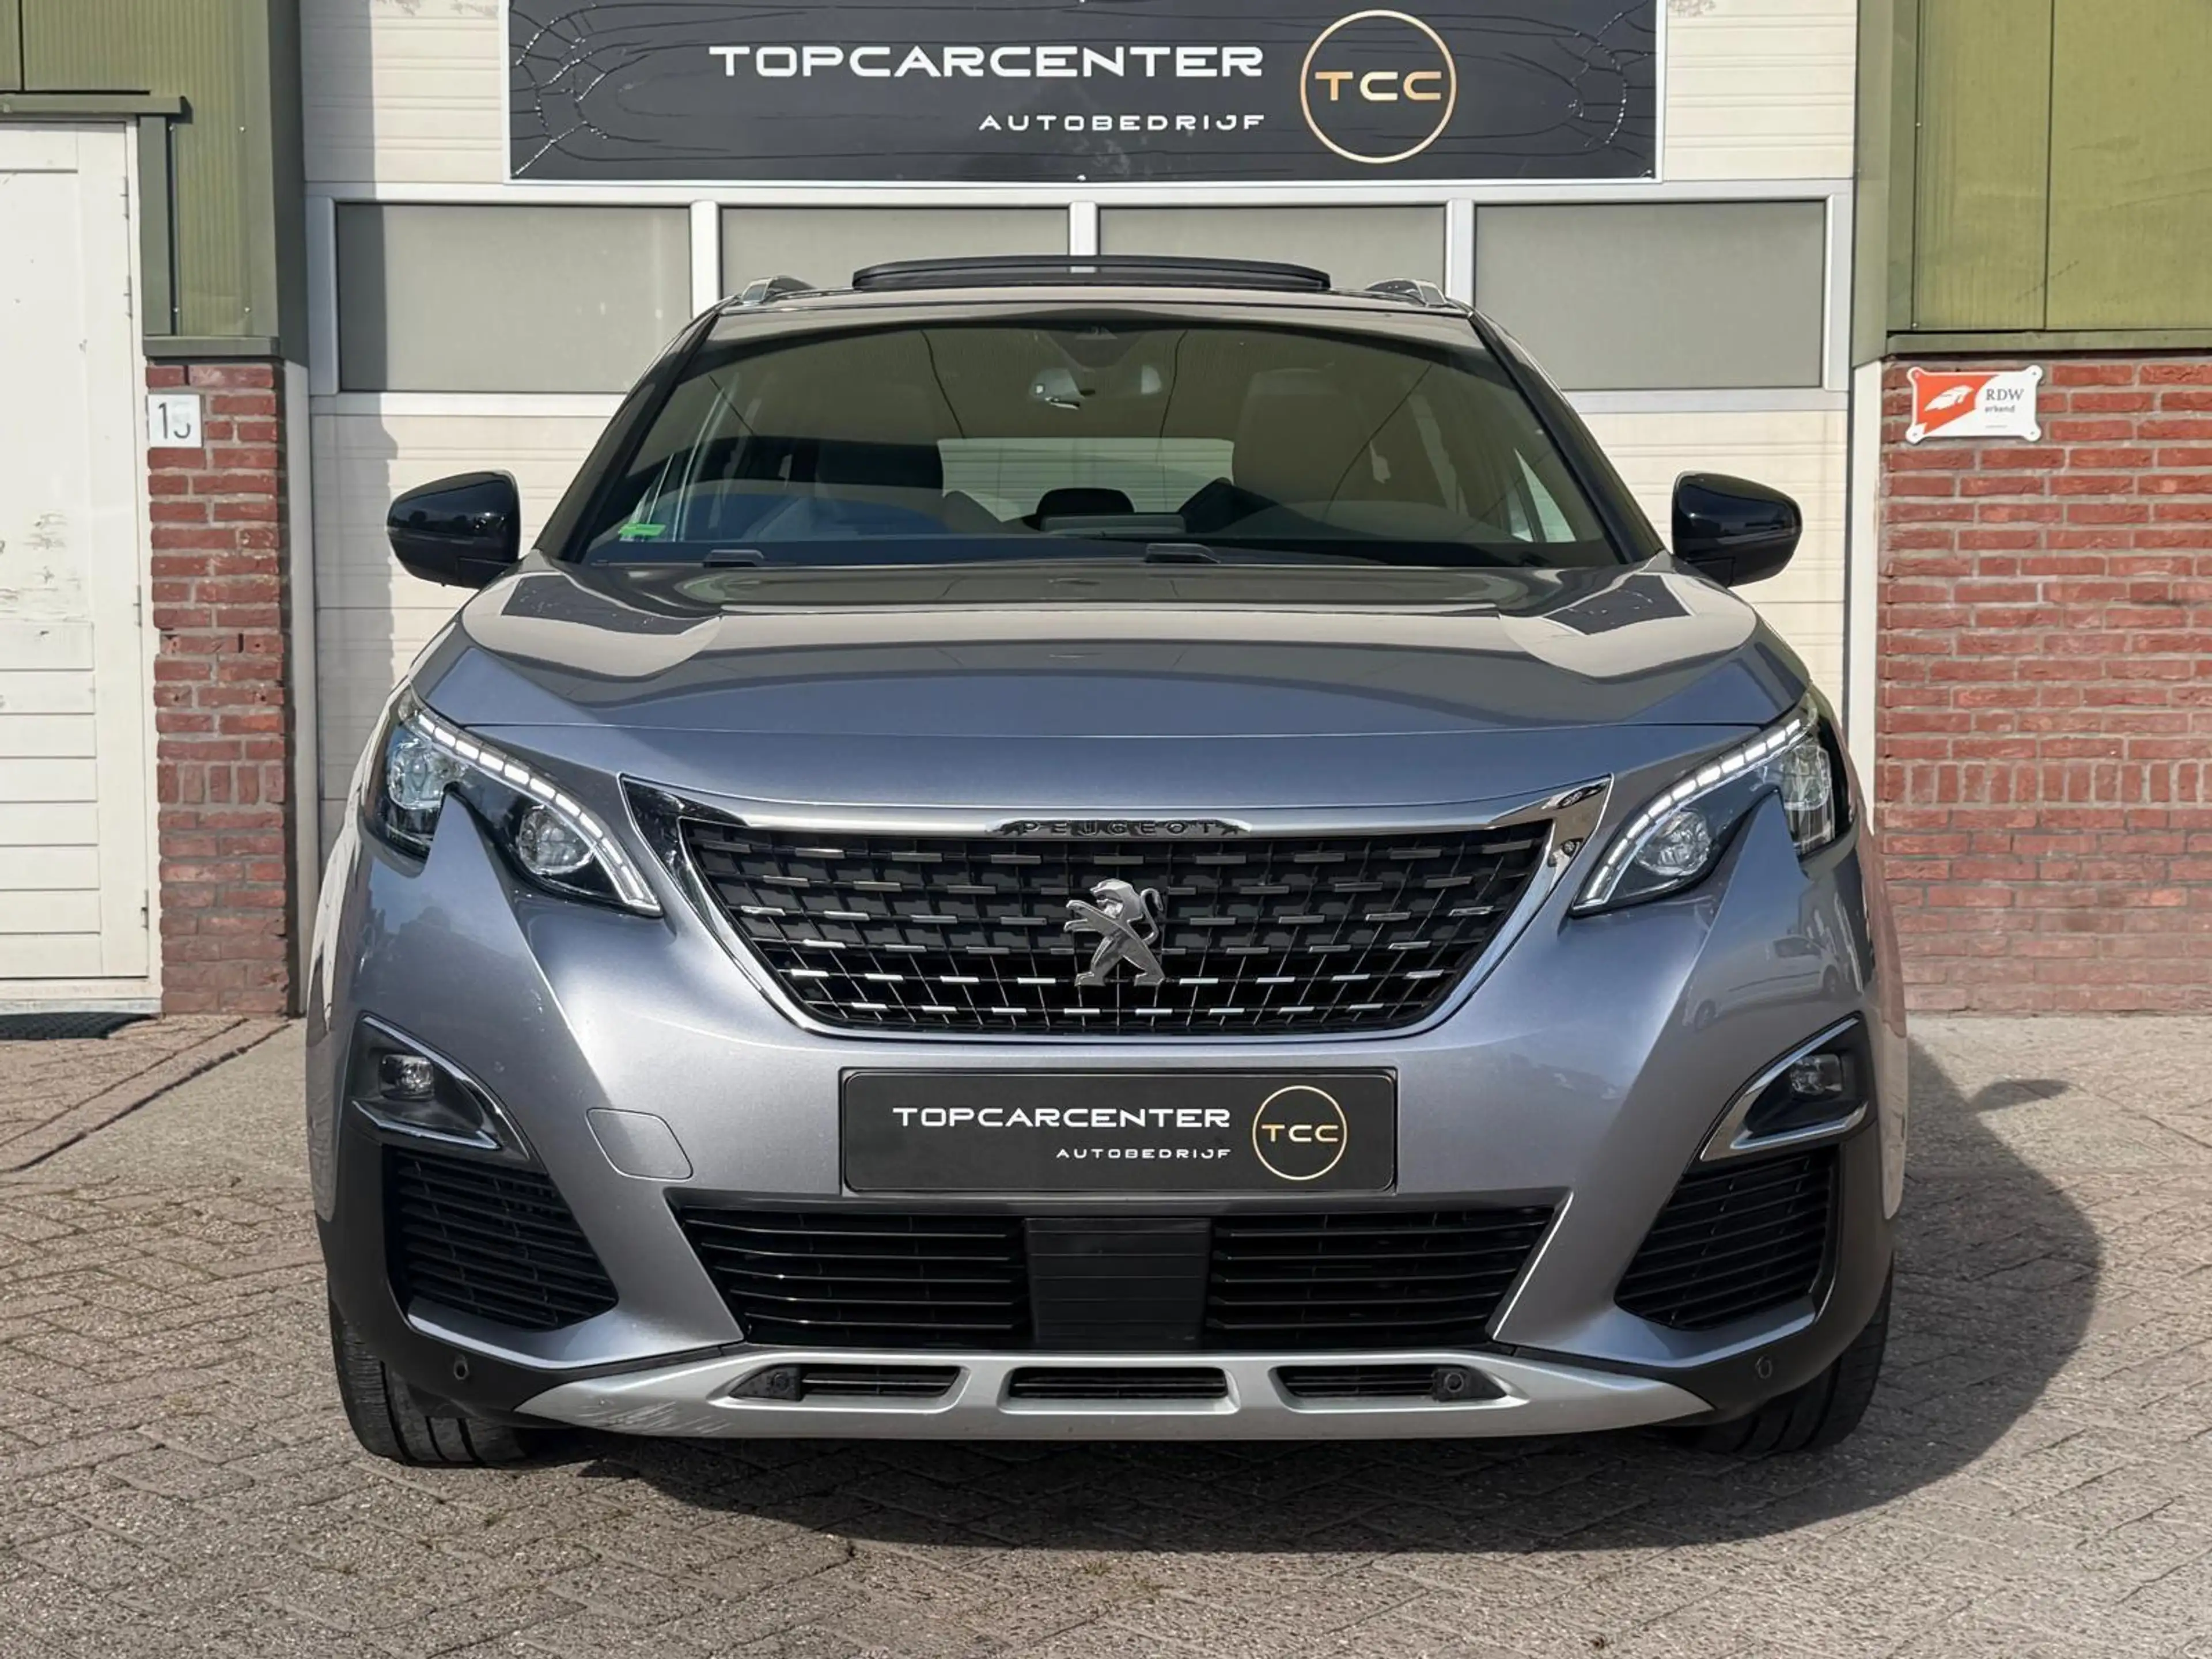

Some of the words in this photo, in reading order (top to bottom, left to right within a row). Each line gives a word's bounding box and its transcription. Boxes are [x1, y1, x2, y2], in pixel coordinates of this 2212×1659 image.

[709, 46, 1263, 77] TOPCARCENTER
[1315, 71, 1442, 101] TCC
[979, 115, 1264, 131] AUTOBEDRIJF
[1986, 388, 2025, 401] RDW
[1021, 820, 1217, 835] PEUGEOT
[892, 1107, 1230, 1128] TOPCARCENTER
[1261, 1124, 1339, 1142] TCC
[1056, 1148, 1231, 1159] AUTOBEDRIJF
